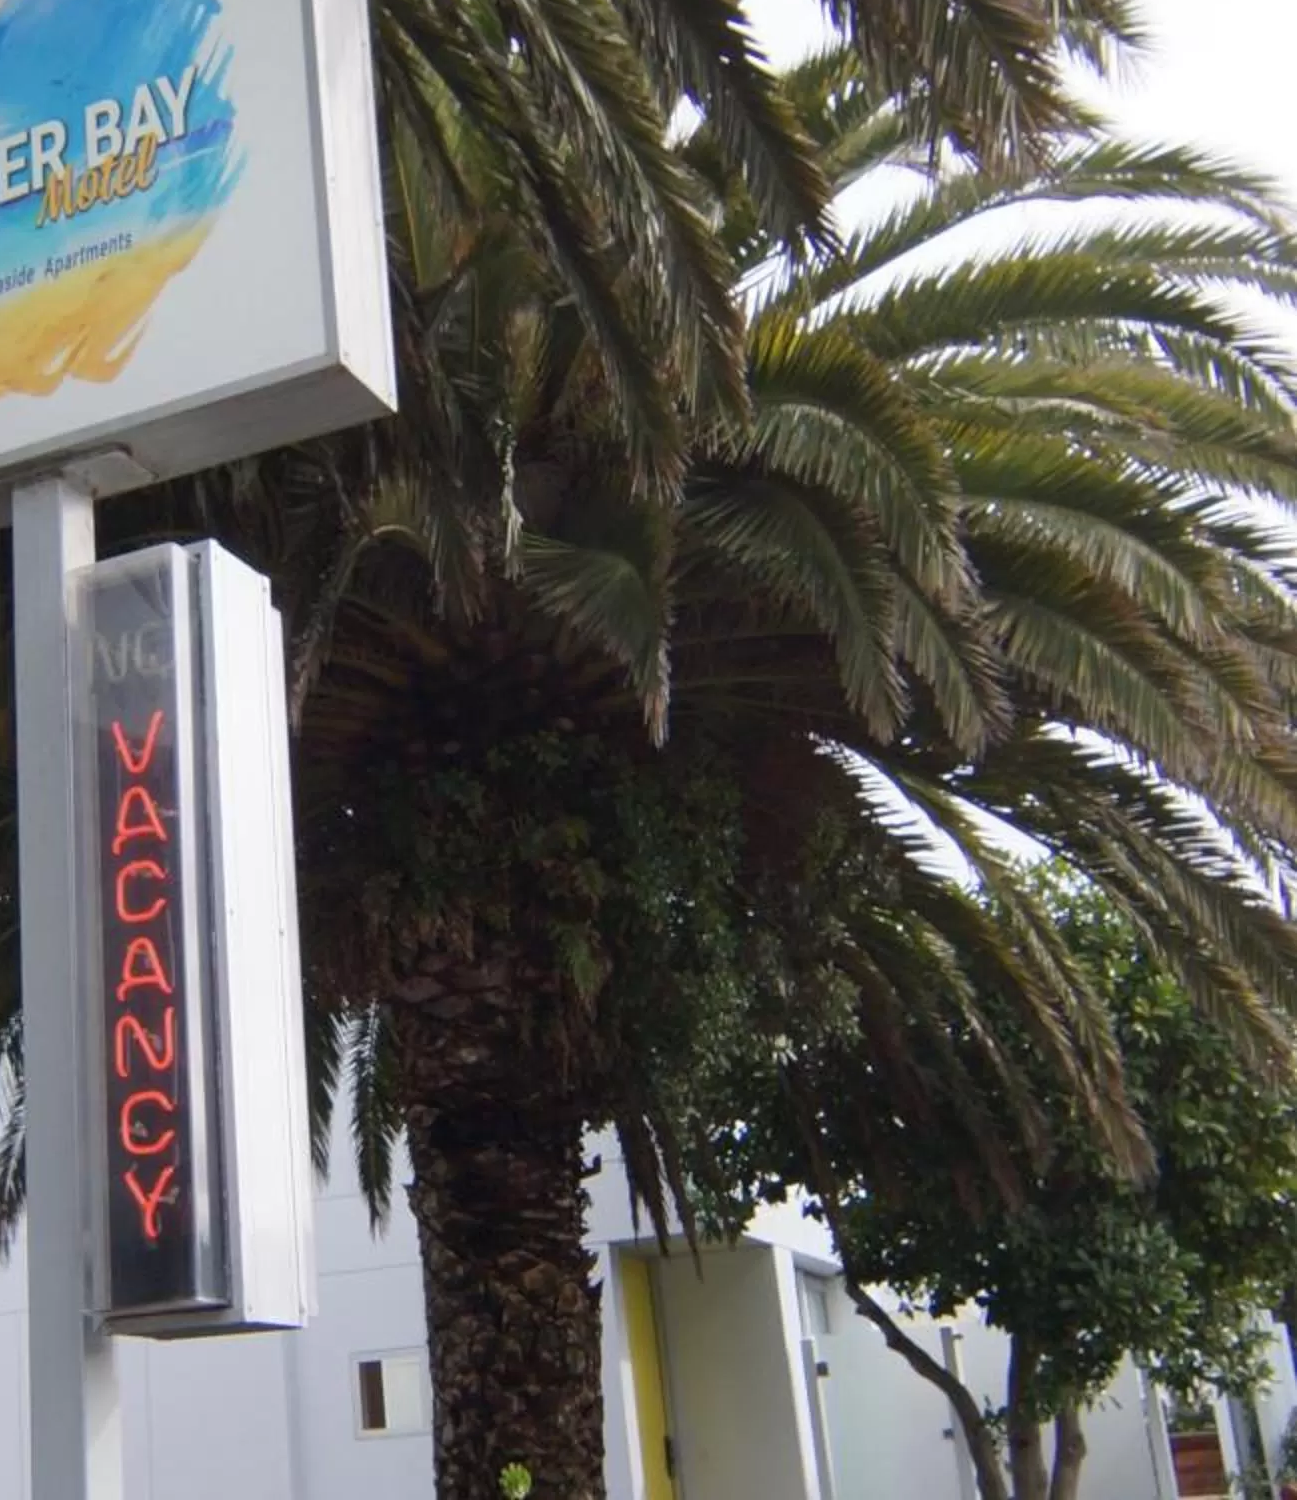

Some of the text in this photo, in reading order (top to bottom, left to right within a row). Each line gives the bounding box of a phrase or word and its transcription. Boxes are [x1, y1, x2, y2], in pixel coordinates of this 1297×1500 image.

[85, 64, 198, 168] BAY
[35, 130, 160, 229] Motel
[43, 231, 134, 279] Apartments
[111, 708, 176, 1242] VACANCY
